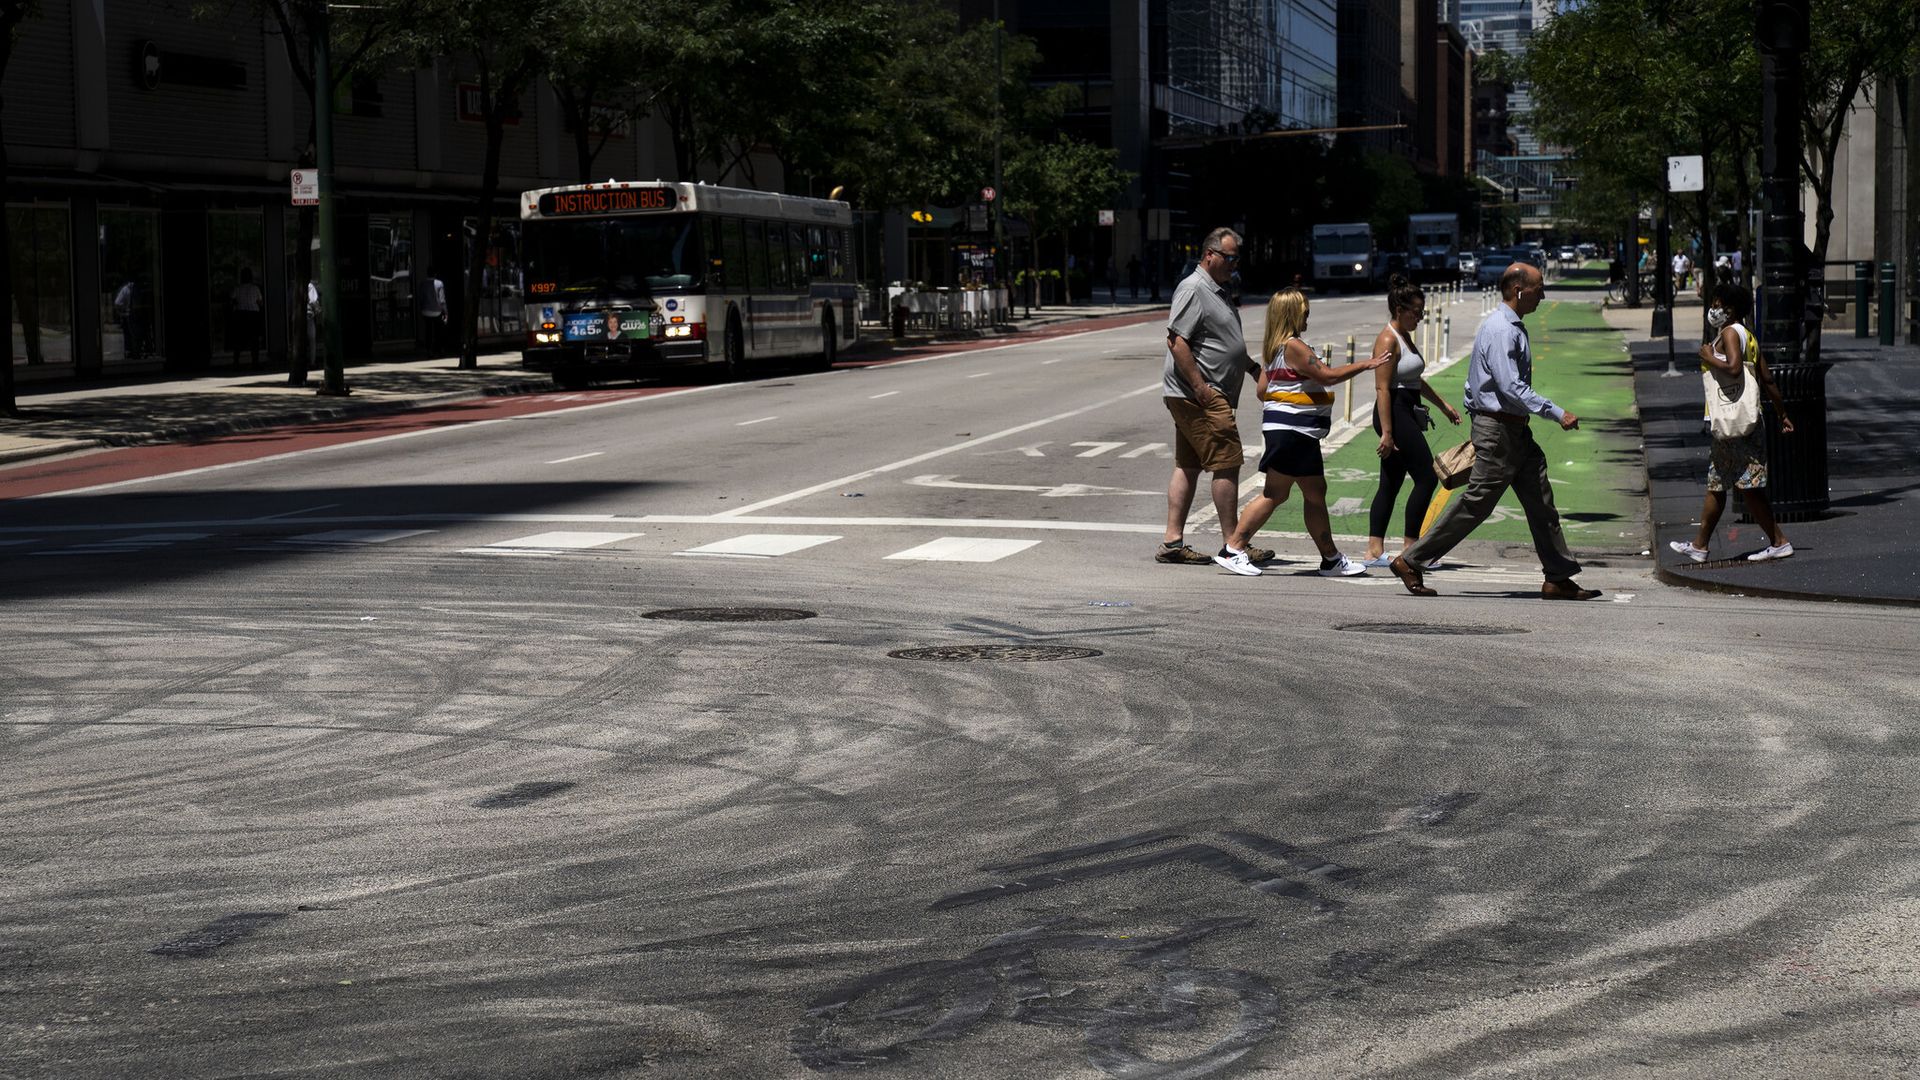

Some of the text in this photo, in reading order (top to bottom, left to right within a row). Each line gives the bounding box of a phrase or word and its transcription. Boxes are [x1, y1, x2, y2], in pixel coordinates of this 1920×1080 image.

[554, 189, 666, 213] INSTRUCTION BUS
[531, 282, 556, 293] K997
